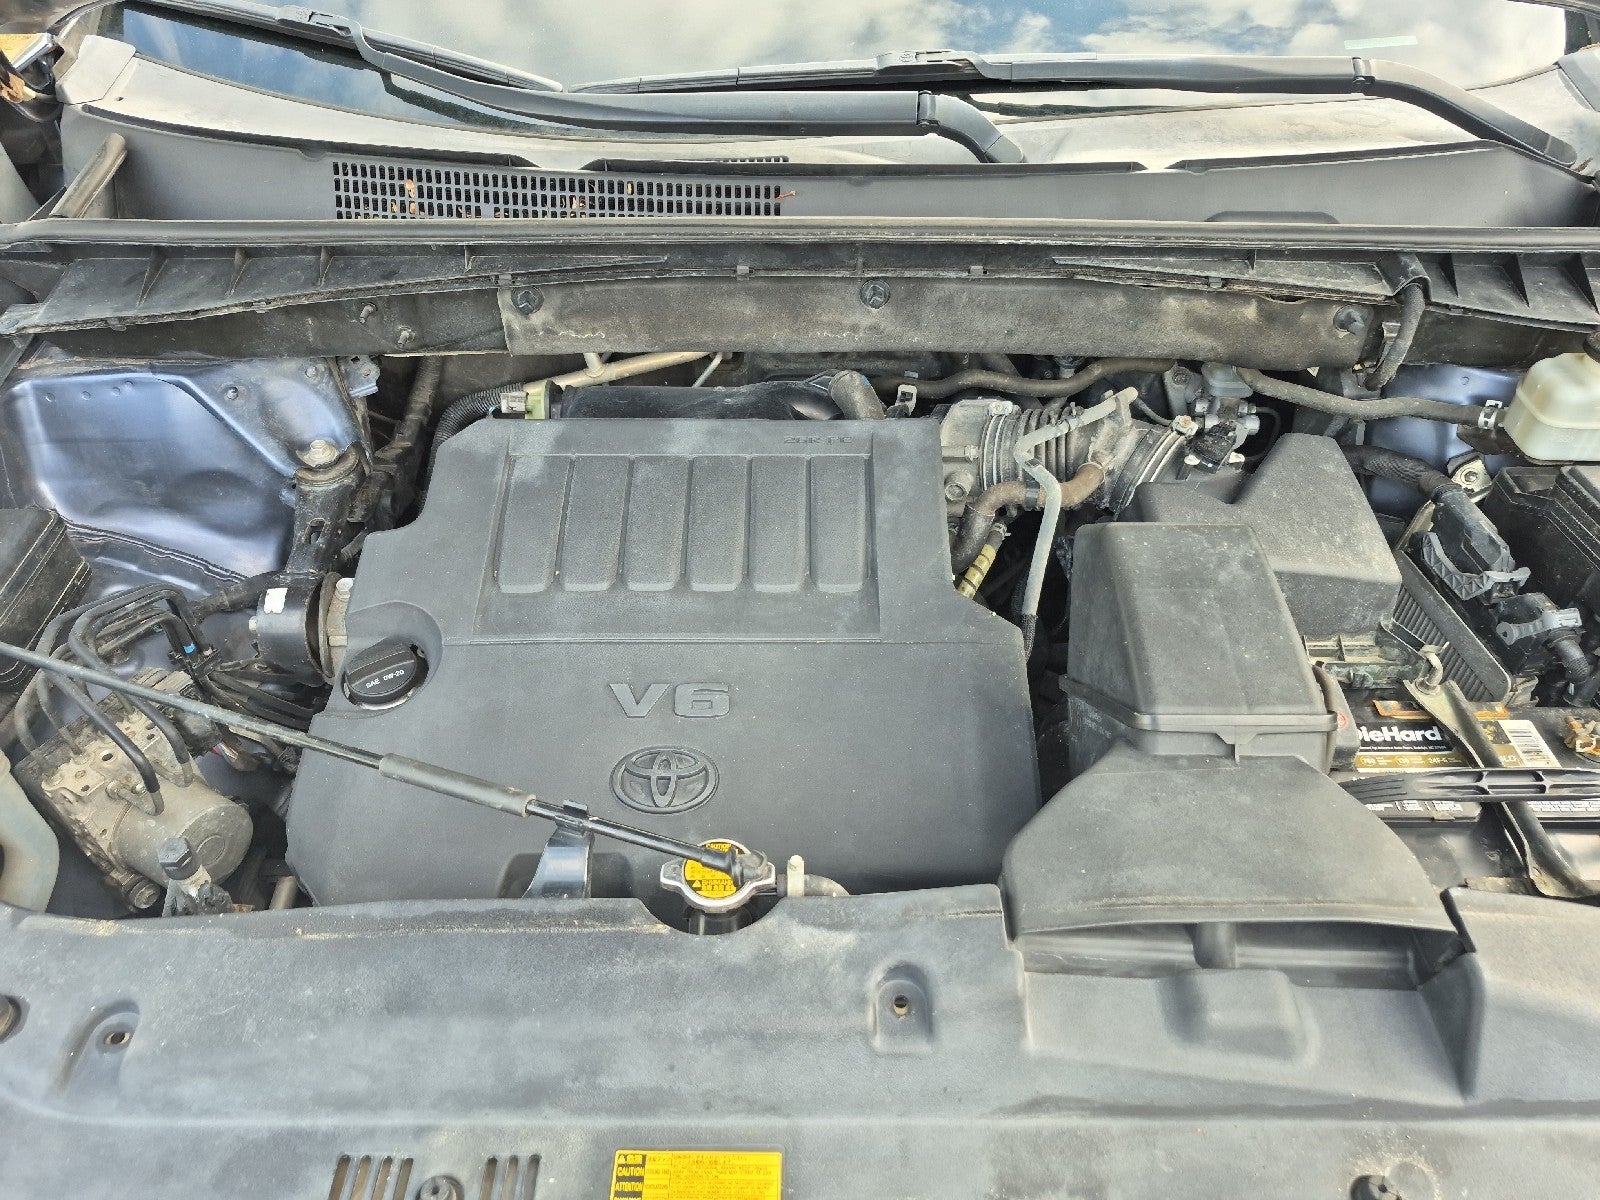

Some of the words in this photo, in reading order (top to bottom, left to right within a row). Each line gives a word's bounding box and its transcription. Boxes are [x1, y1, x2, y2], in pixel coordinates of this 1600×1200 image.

[366, 678, 380, 688] SAE
[383, 669, 404, 680] 0W-20
[609, 682, 731, 718] V6
[617, 1166, 645, 1177] CAUTION
